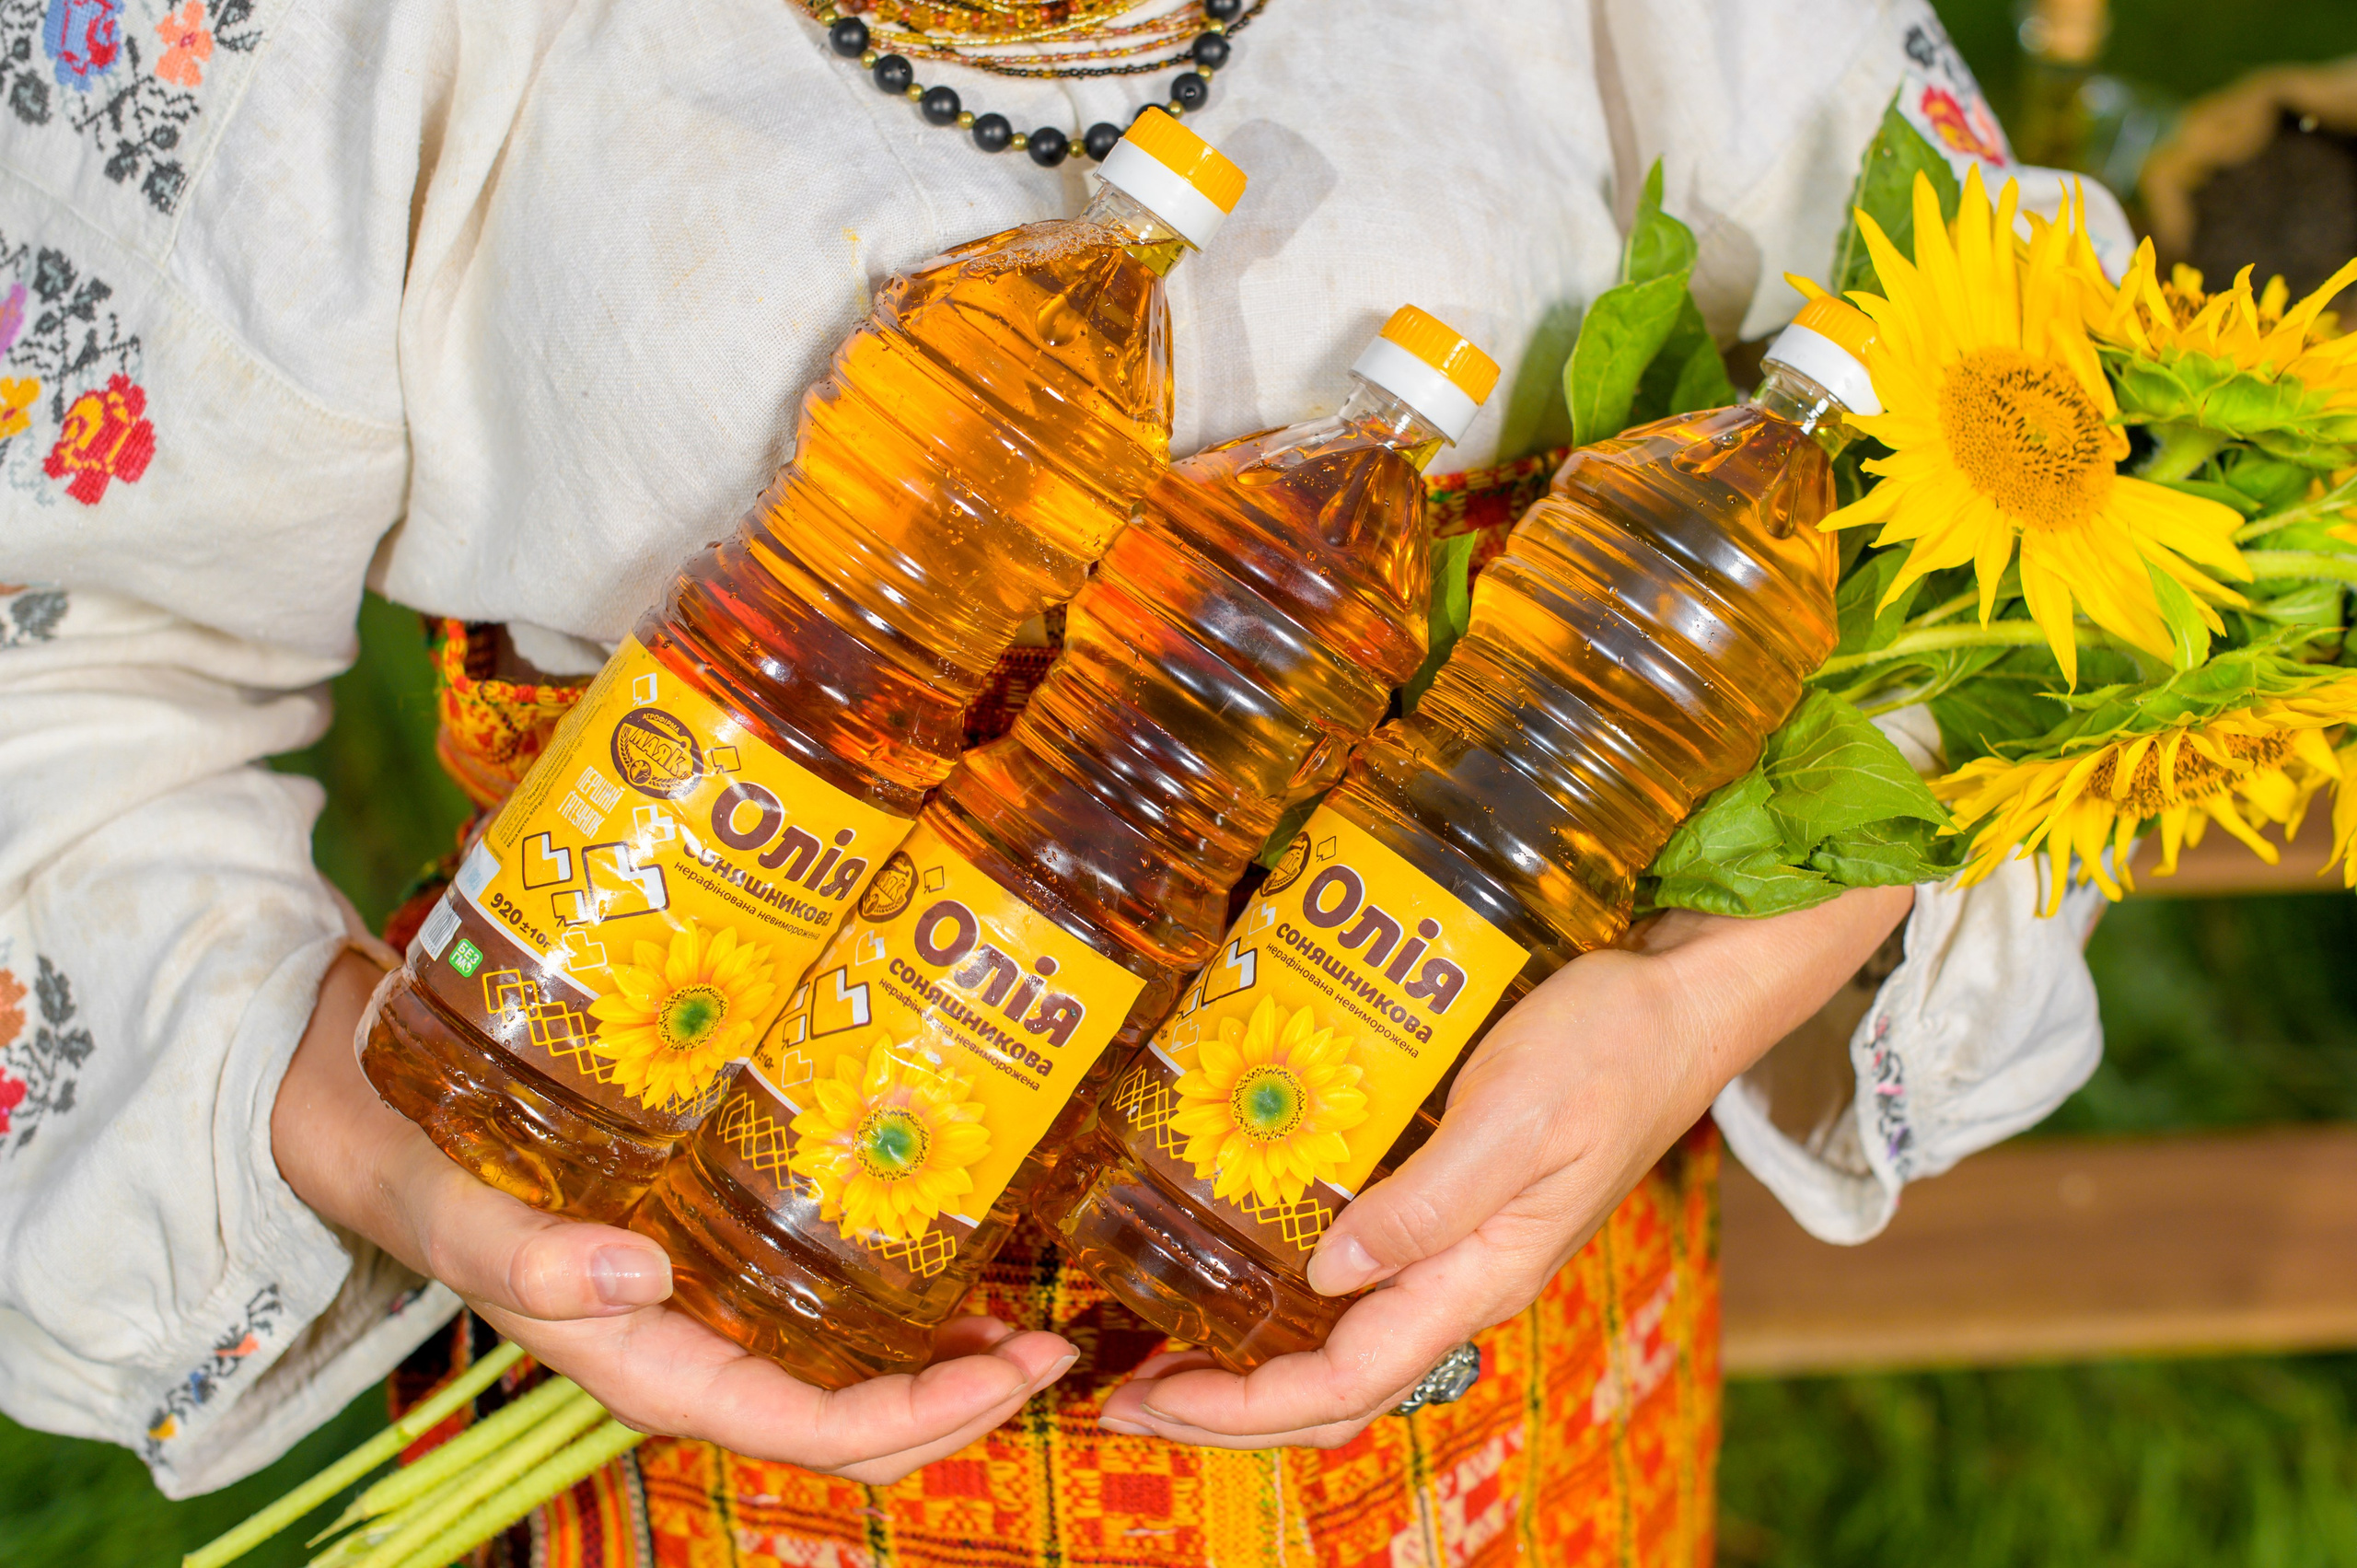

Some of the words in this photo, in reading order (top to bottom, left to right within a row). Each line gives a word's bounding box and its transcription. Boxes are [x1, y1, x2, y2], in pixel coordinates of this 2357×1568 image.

[629, 727, 686, 777] МАЯК
[643, 713, 680, 734] АГРОФІРМА
[575, 765, 626, 814] ПЕРШИЙ
[683, 839, 833, 927] соняшникова
[711, 781, 869, 901] Олія
[674, 861, 757, 915] нерафінована
[756, 911, 821, 941] невиморожена
[1303, 864, 1469, 1015] Олія
[451, 951, 473, 973] ГМО
[457, 941, 480, 965] БЕЗ
[914, 900, 1086, 1049] Олія
[1265, 942, 1335, 997] нерафінована
[1334, 993, 1420, 1059] невиморожена
[1276, 923, 1434, 1044] соняшникова
[878, 977, 954, 1037] нерафінована
[953, 1030, 1041, 1092] невиморожена
[888, 958, 1054, 1077] соняшникова
